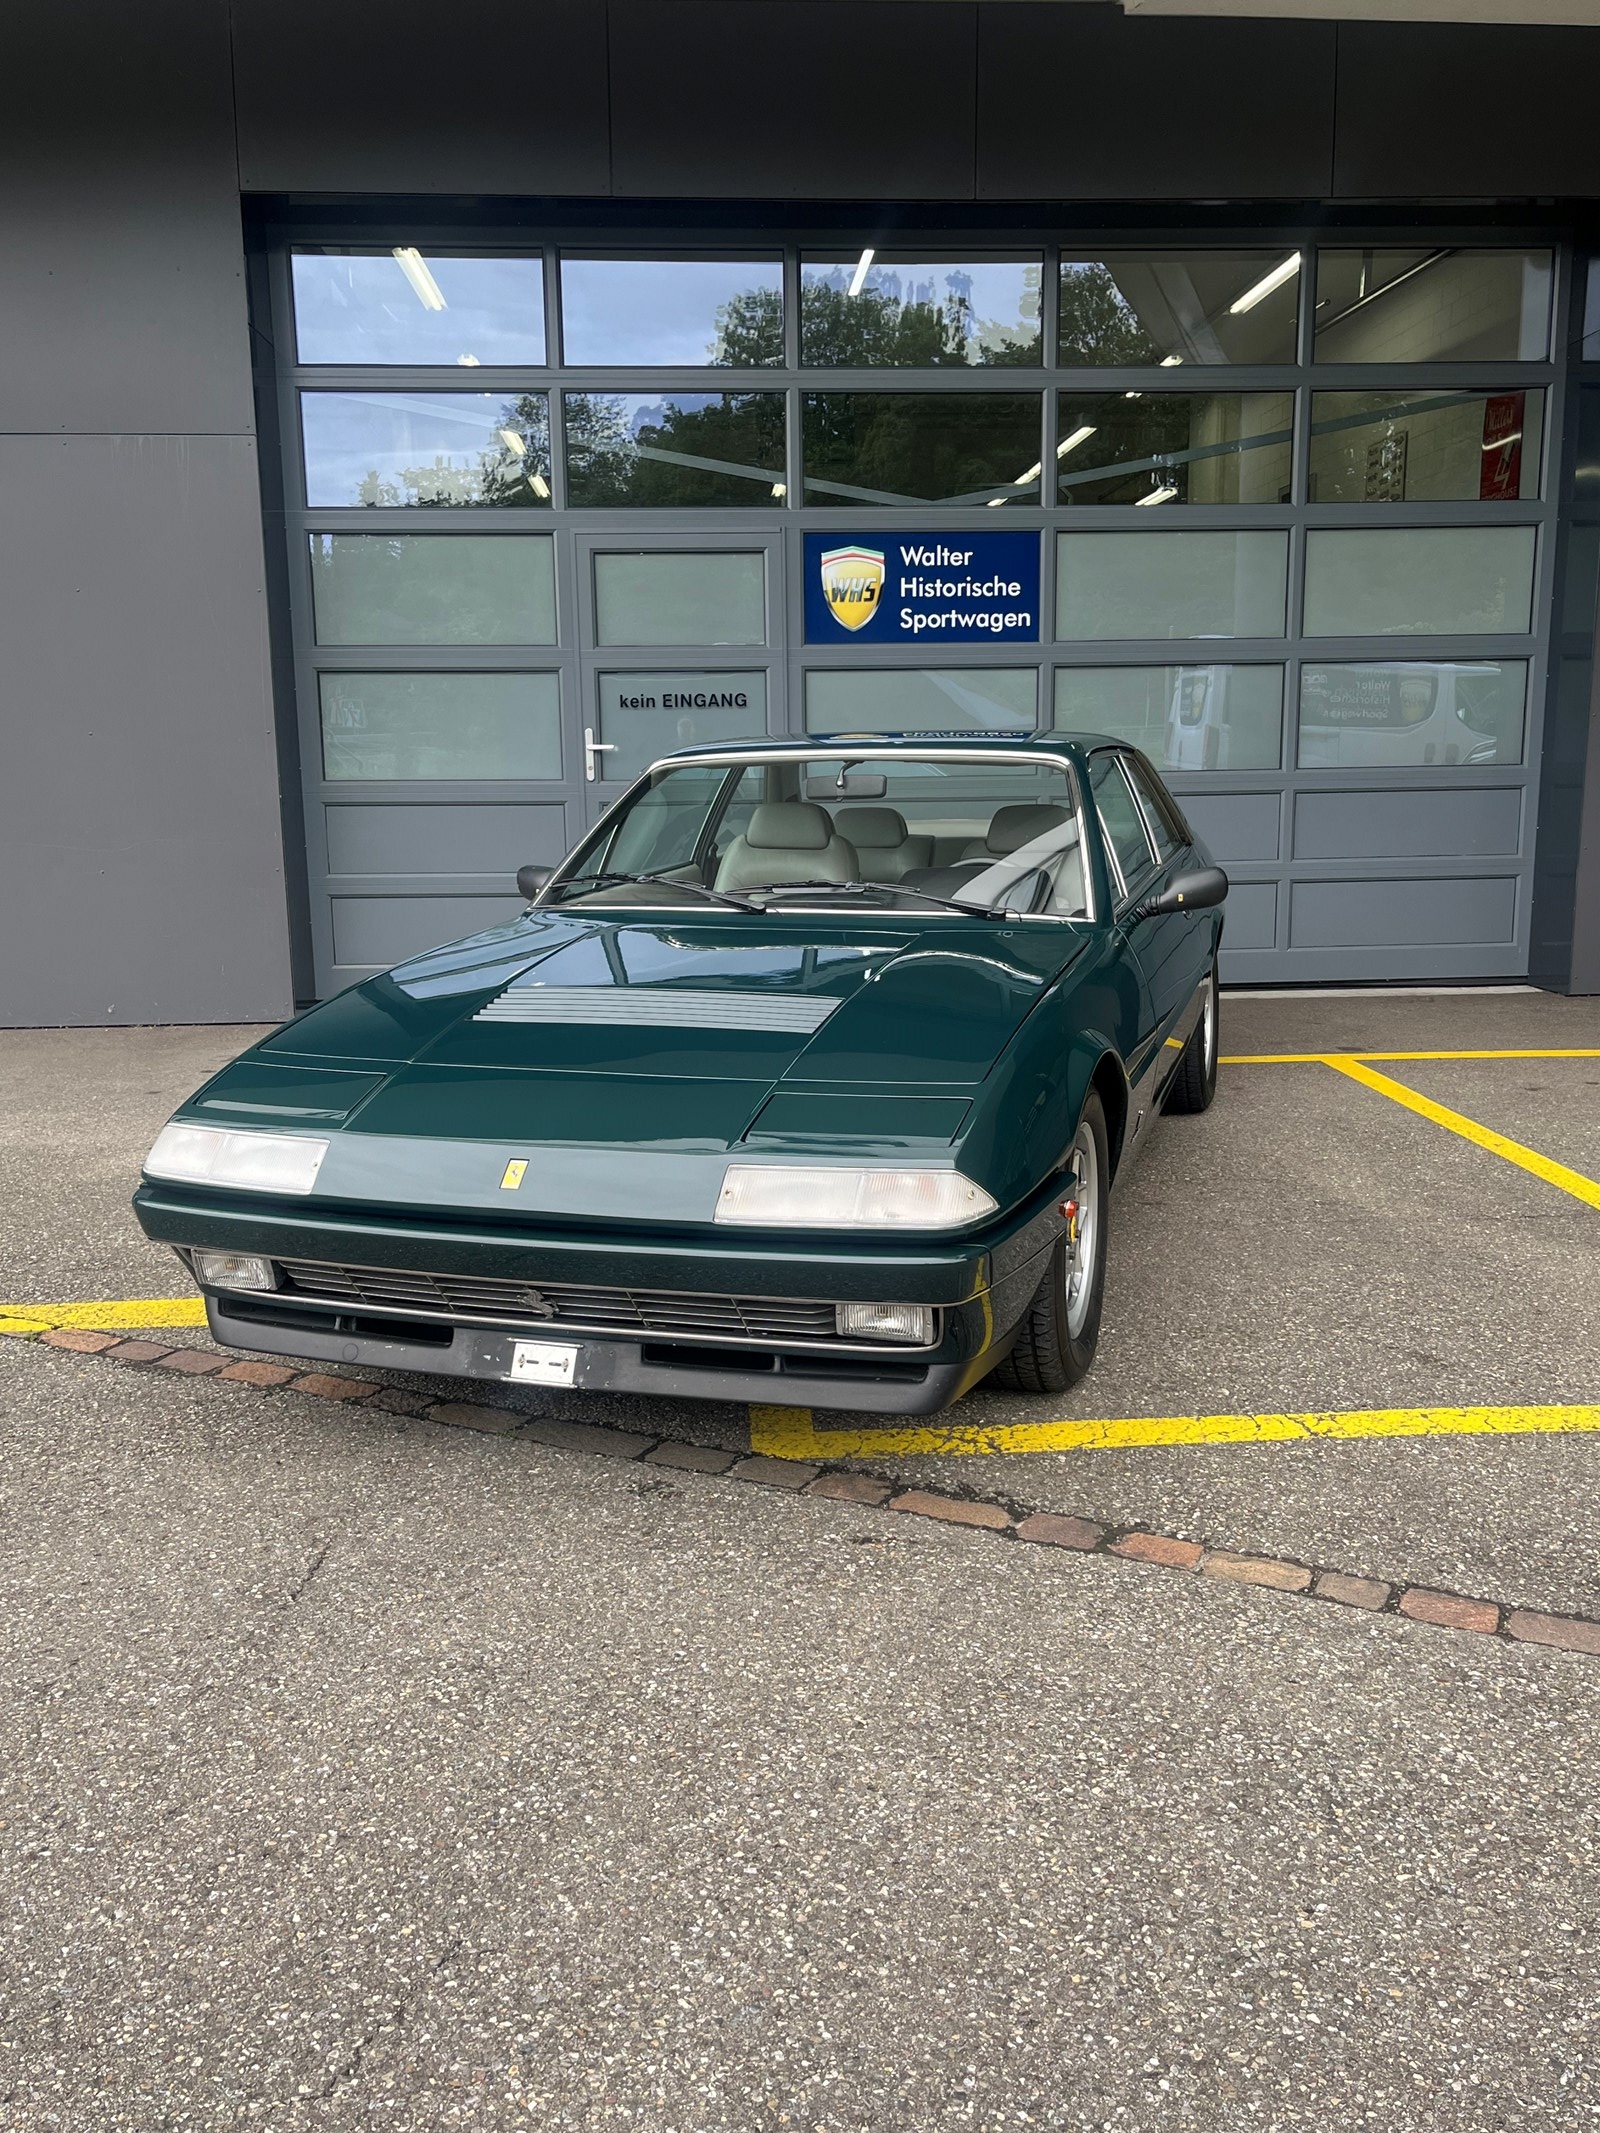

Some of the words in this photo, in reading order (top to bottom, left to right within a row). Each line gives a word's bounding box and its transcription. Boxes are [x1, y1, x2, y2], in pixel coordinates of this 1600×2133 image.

[900, 545, 973, 566] Walter
[831, 577, 877, 602] WHS
[900, 575, 1021, 597] Historische
[900, 608, 1031, 633] Sportwagen
[619, 694, 656, 708] kein
[662, 693, 747, 708] EINGANG
